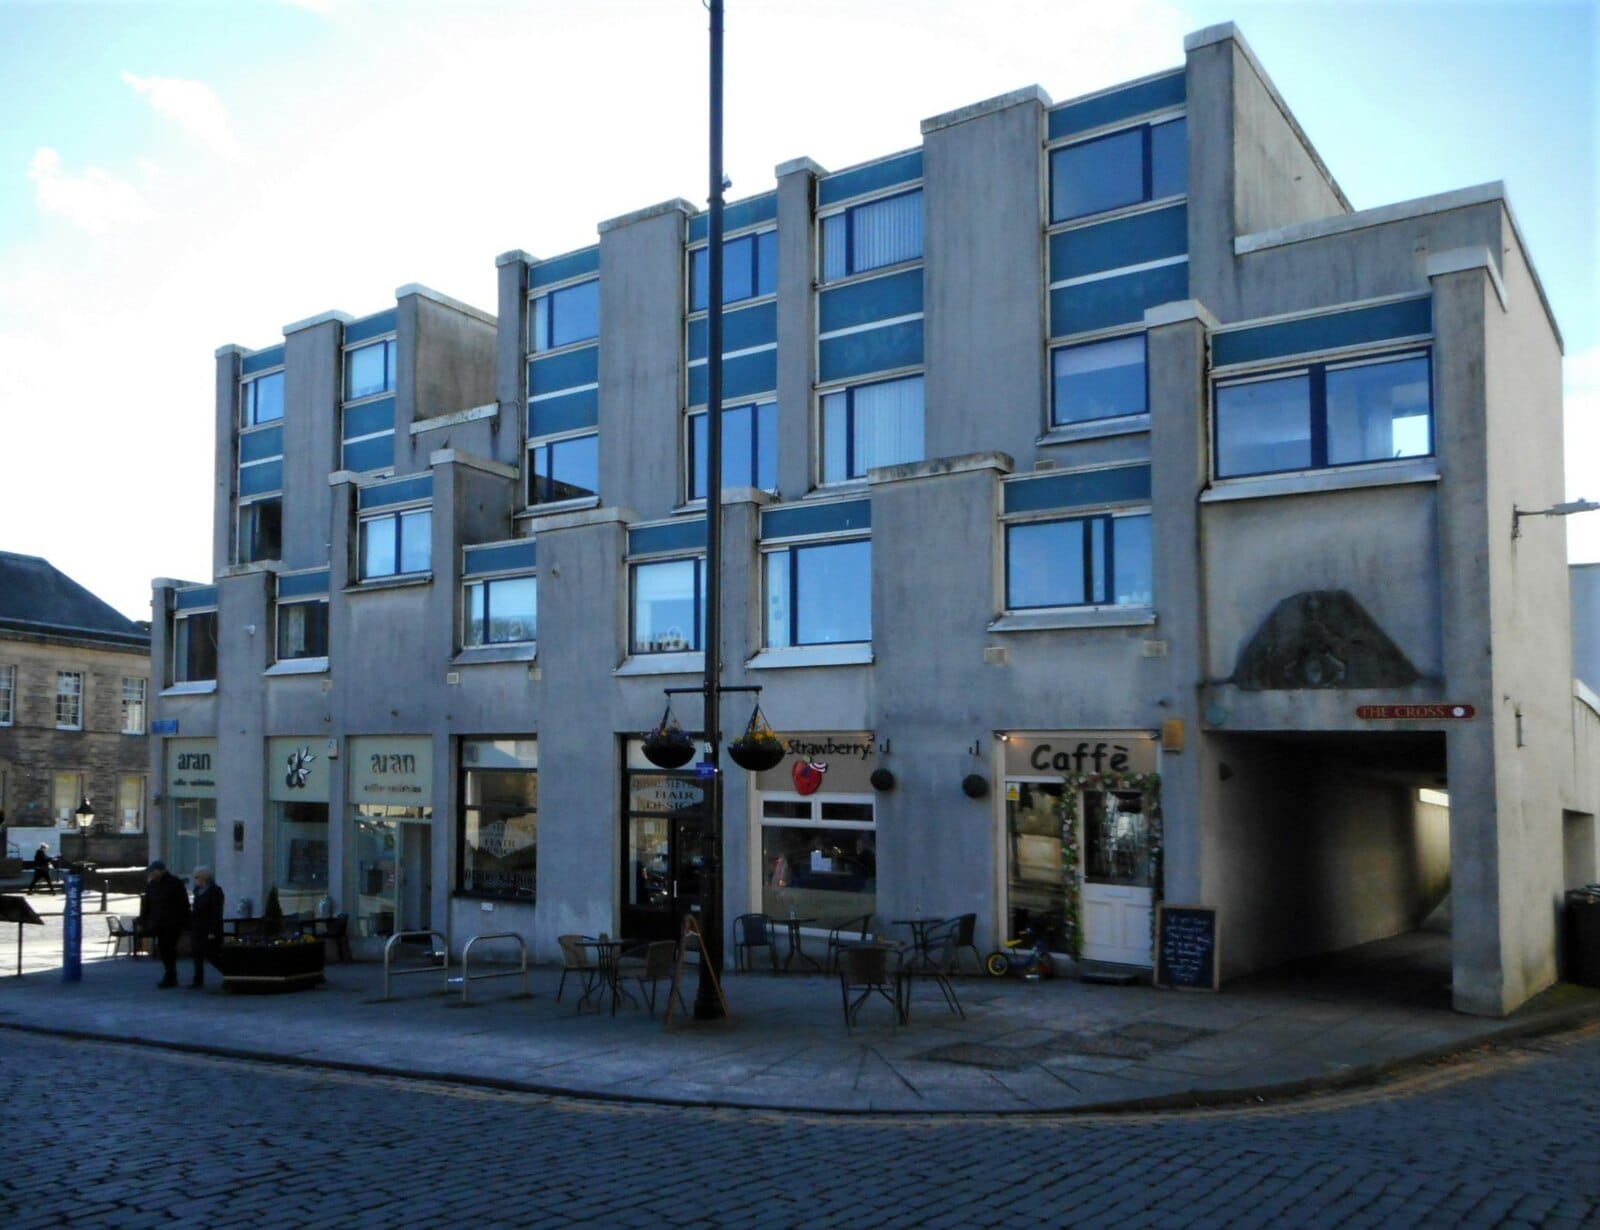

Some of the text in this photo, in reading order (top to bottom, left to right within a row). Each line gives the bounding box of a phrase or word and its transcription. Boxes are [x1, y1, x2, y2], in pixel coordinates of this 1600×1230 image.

[1361, 707, 1444, 718] THE CROSS
[177, 749, 210, 770] aran
[370, 753, 416, 774] aran
[1031, 743, 1129, 772] Caffè
[655, 791, 694, 800] HAIR
[646, 800, 694, 809] DESIG
